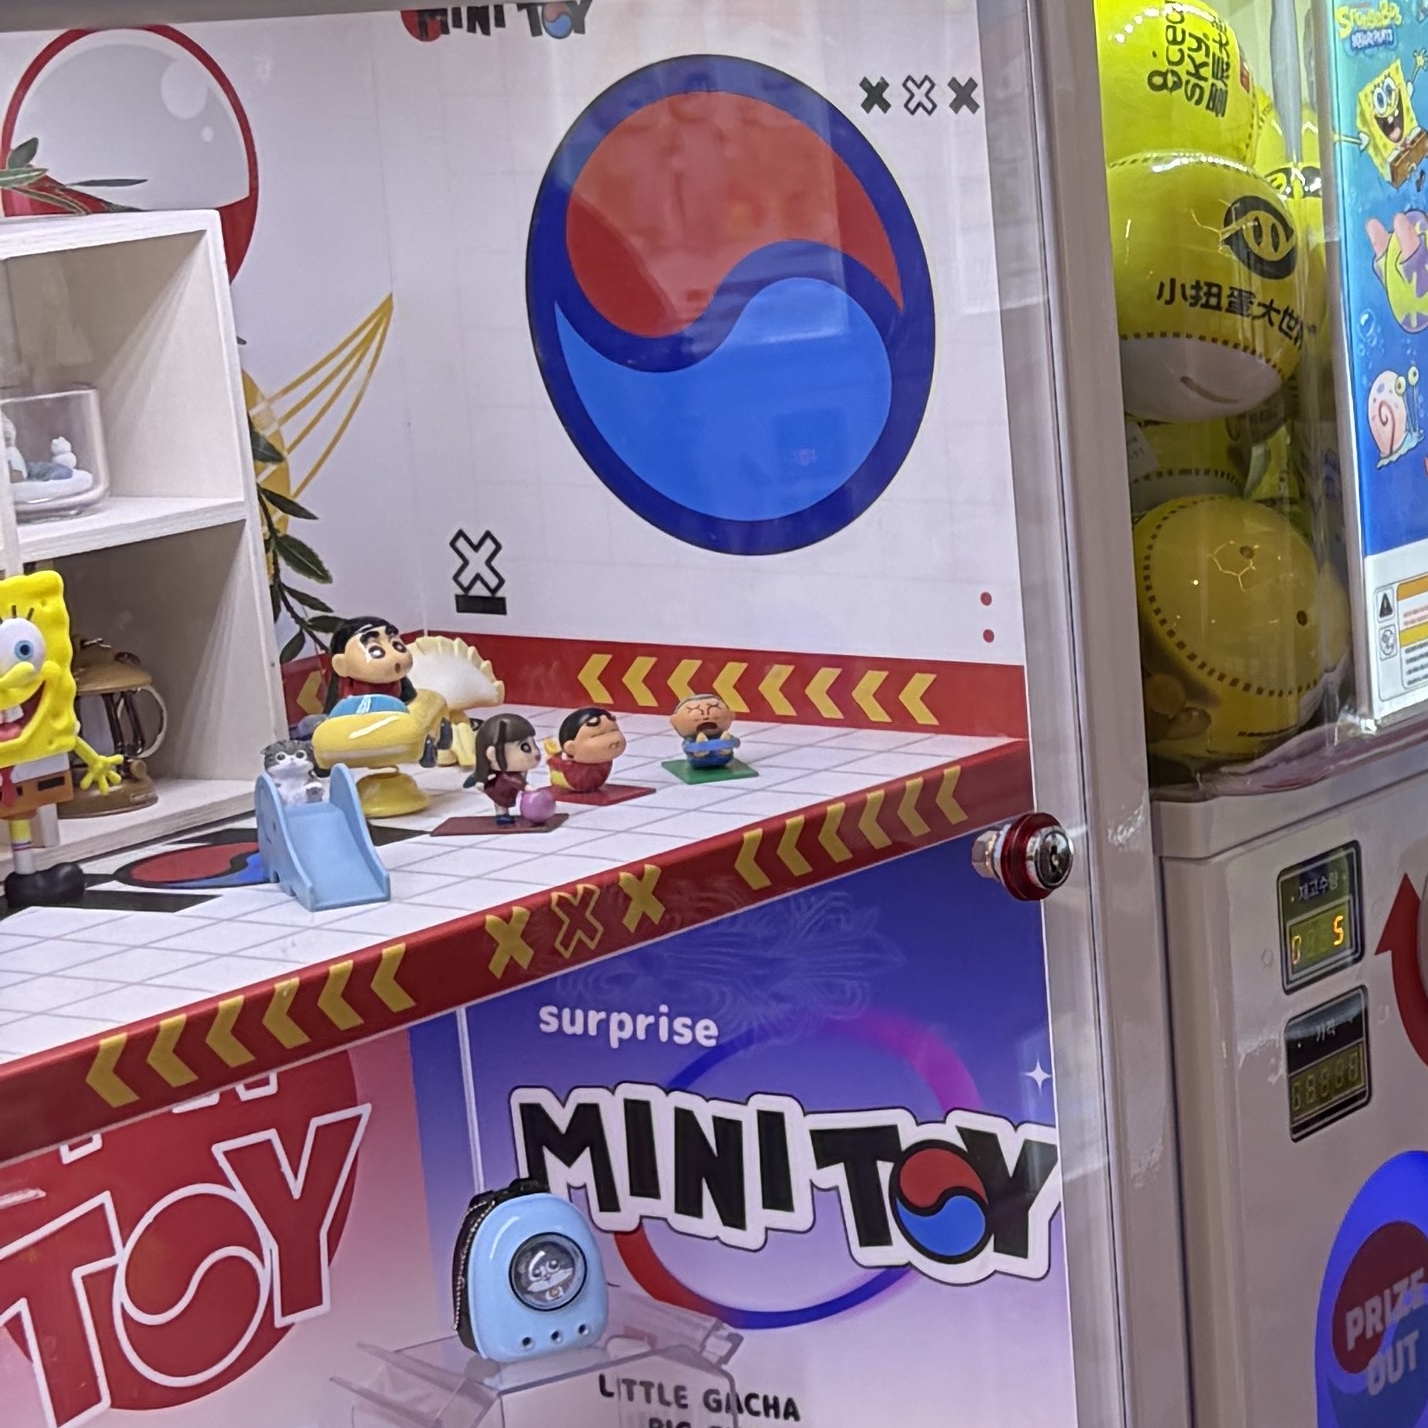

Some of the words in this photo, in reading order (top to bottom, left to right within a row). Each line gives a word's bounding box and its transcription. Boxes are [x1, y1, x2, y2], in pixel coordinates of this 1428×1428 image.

[1155, 277, 1305, 351] 小扭蛋大世
[538, 1003, 720, 1050] surprise
[514, 1093, 801, 1240] MINI
[808, 1122, 1060, 1267] TOY
[1344, 1267, 1427, 1352] PRIZE
[598, 1372, 690, 1411] LITTLE
[702, 1382, 801, 1422] GACHA
[1366, 1329, 1420, 1398] OUT
